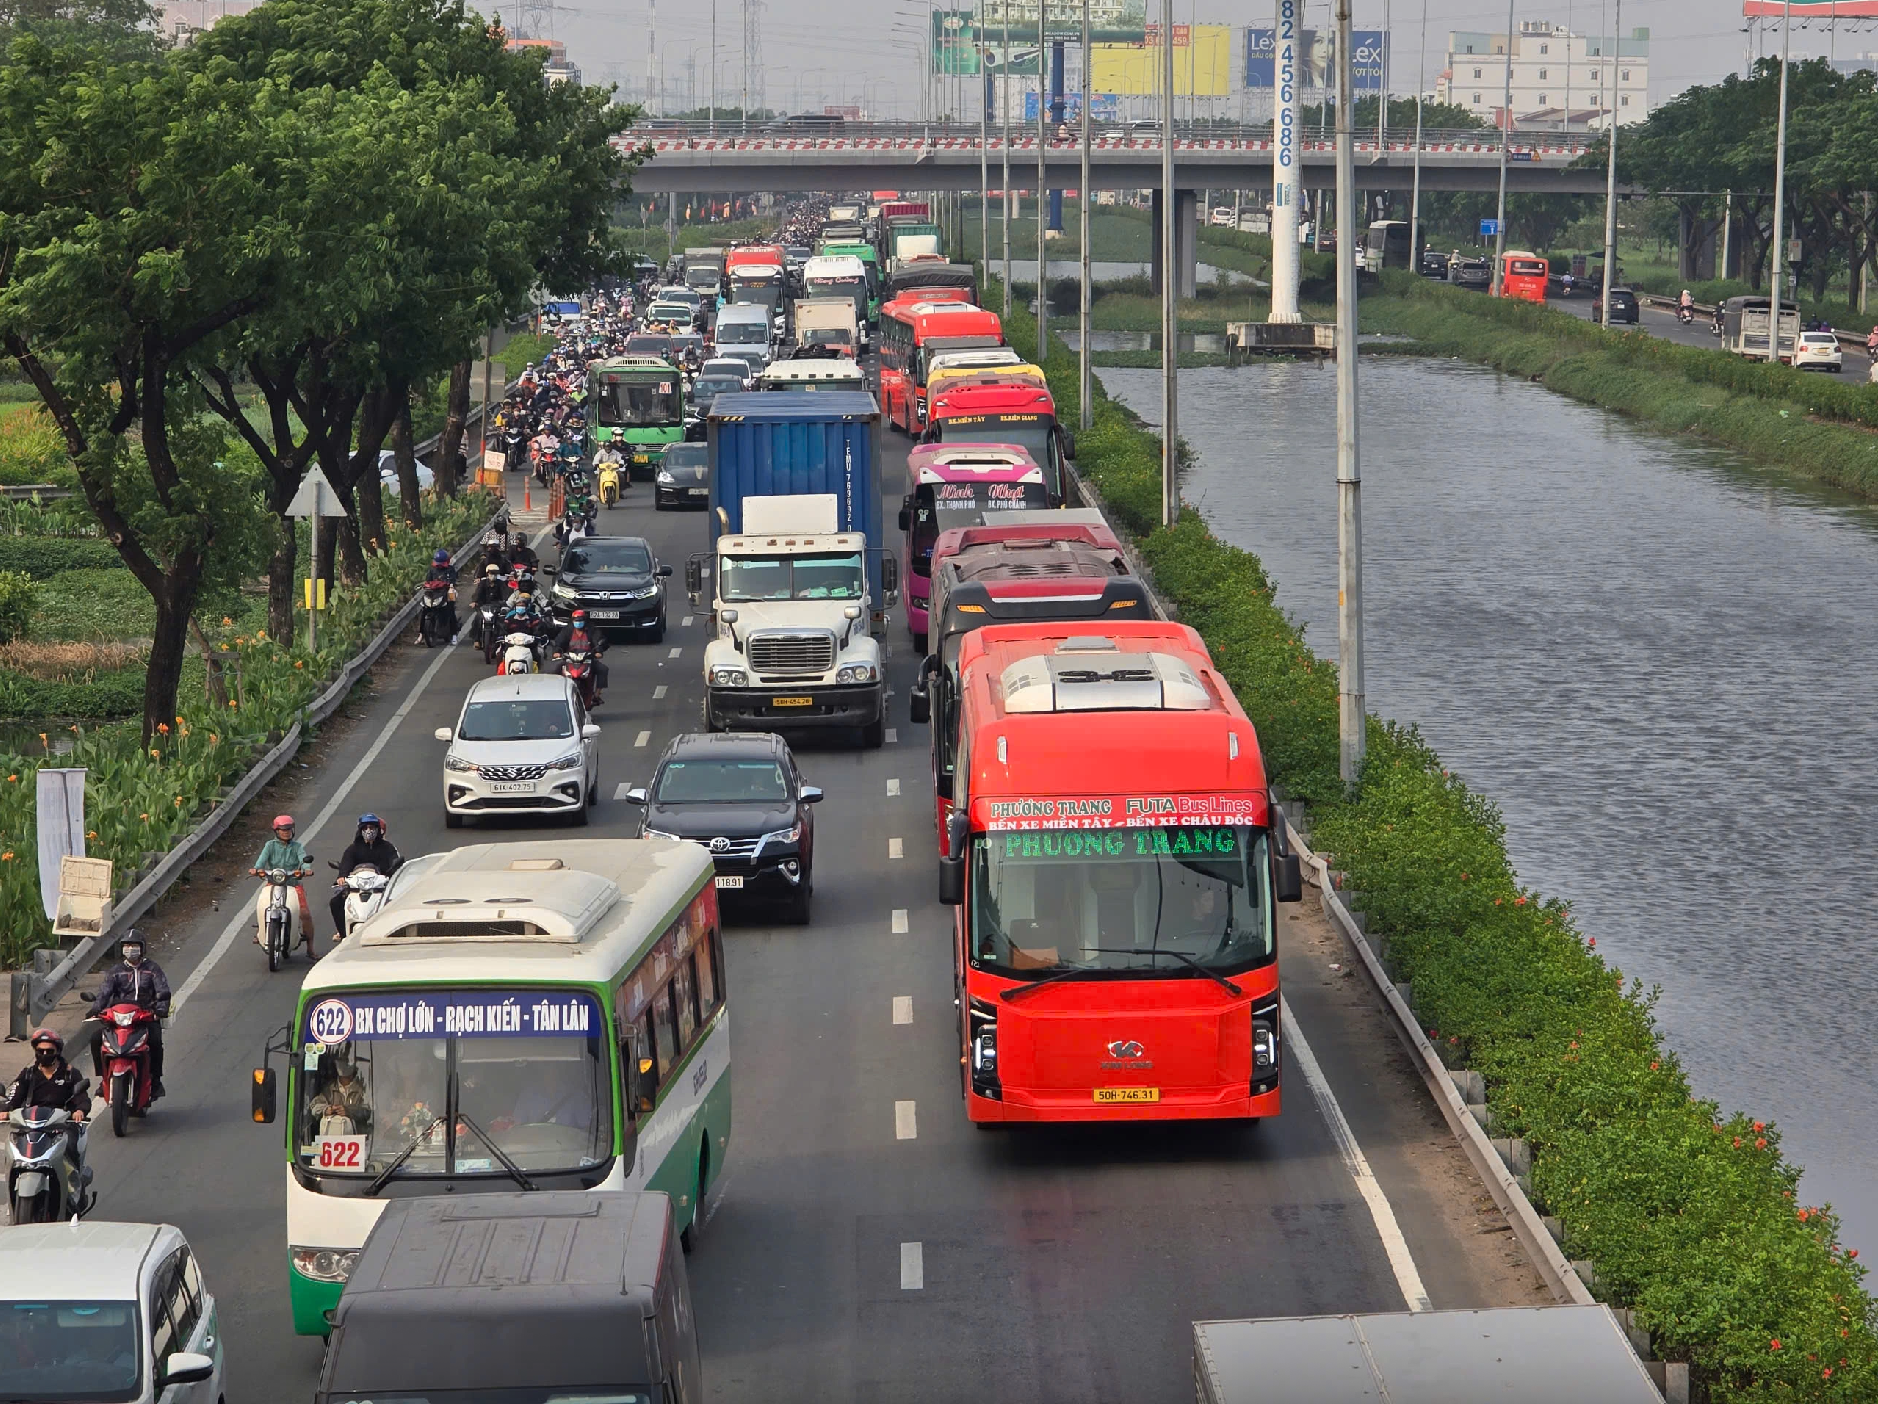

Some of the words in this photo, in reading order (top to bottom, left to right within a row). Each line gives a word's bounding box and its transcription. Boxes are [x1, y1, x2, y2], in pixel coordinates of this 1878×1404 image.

[1352, 38, 1381, 63] éx
[1281, 45, 1294, 103] 456
[1279, 107, 1293, 167] 686
[937, 483, 975, 499] Minh
[991, 798, 1054, 817] PHƯƠNG
[1057, 799, 1112, 815] TRANG
[1126, 797, 1177, 814] FUTA
[1179, 797, 1208, 813] Bus
[1209, 797, 1252, 813] Lines
[989, 818, 1017, 830] BẾN
[1019, 820, 1040, 830] XE
[1042, 816, 1079, 829] MIỀN
[1081, 816, 1113, 828] TÂY
[1126, 815, 1156, 827] BẾN
[1158, 816, 1178, 826] XE
[1181, 814, 1221, 826] CHÂU
[1224, 811, 1253, 826] ĐỐC
[1132, 829, 1235, 855] TRANG
[316, 1007, 345, 1036] 622
[355, 1007, 374, 1034] BX
[376, 1002, 407, 1039] CHỢ
[408, 1000, 434, 1033] LỚN
[445, 1005, 484, 1037] RẠCH
[486, 997, 520, 1032] KIẾN
[532, 999, 560, 1031] TÂN
[562, 999, 589, 1031] LÂN
[320, 1141, 360, 1168] 622
